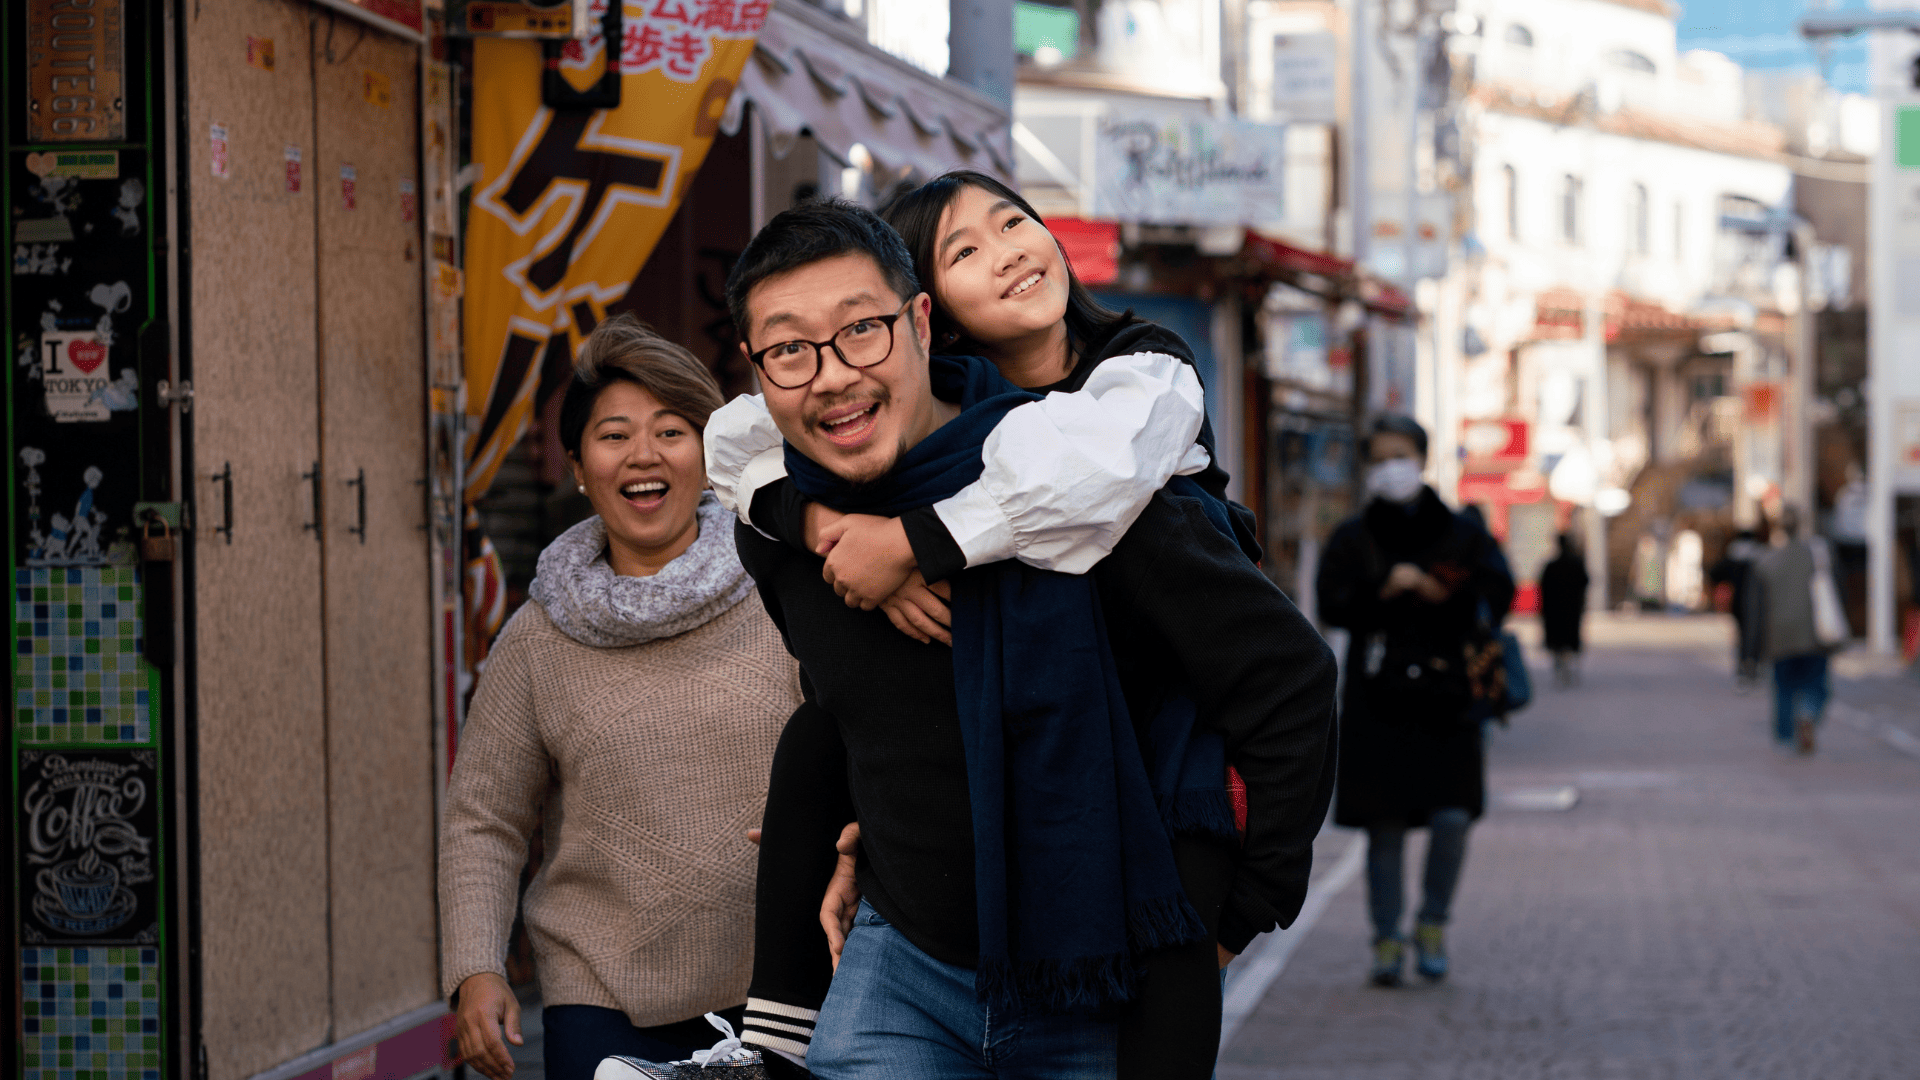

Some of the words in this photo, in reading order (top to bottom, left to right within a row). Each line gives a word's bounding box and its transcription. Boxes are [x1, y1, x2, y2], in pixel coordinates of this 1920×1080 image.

[632, 0, 772, 33] ム満点
[45, 340, 62, 374] I
[46, 379, 108, 394] TOKYO
[24, 777, 146, 855] Coffee
